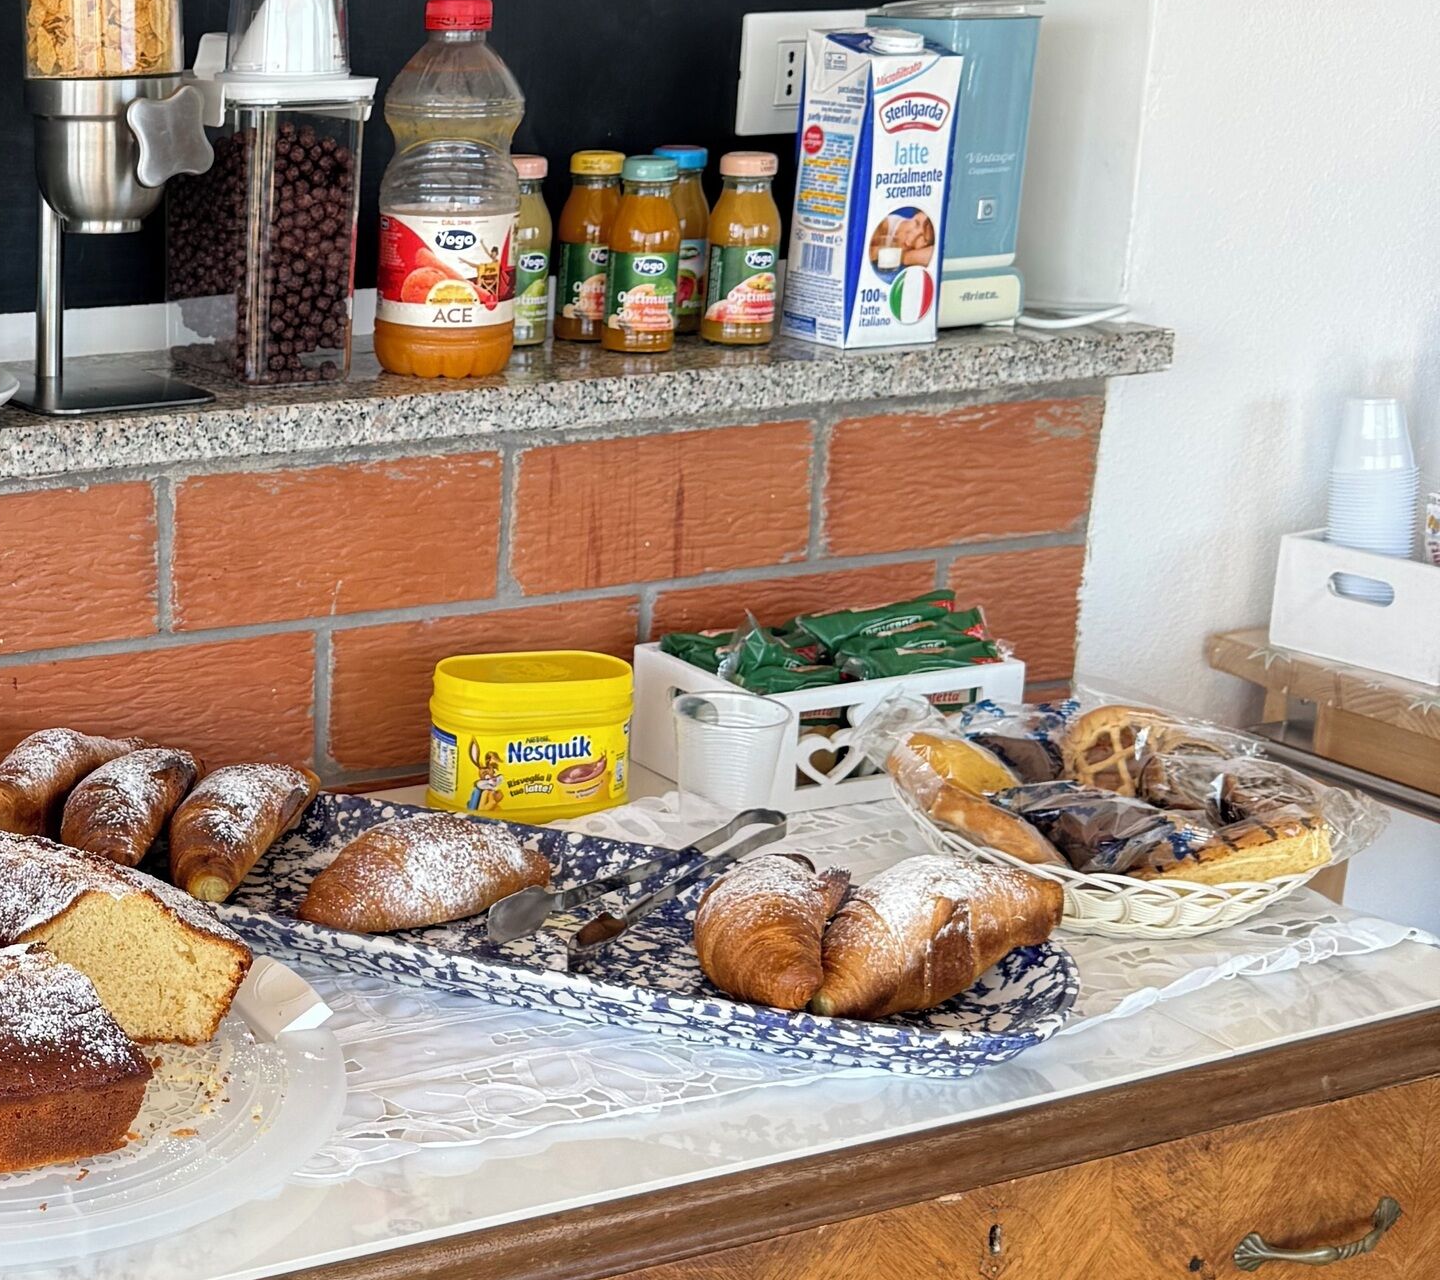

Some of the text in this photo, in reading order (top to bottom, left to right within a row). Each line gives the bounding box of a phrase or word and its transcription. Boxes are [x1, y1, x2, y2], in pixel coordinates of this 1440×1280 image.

[884, 100, 944, 123] sterilgarda
[894, 140, 929, 166] latte
[875, 167, 943, 189] parzialmente
[885, 184, 932, 199] scremato
[437, 230, 474, 249] Yoga
[634, 257, 664, 273] Yoga
[432, 307, 473, 323] ACE
[860, 305, 881, 315] latte
[859, 316, 891, 327] italiano
[507, 735, 592, 766] Nesquik
[507, 773, 552, 789] Risveglia il
[509, 788, 524, 798] tuo
[524, 783, 554, 795] latte!
